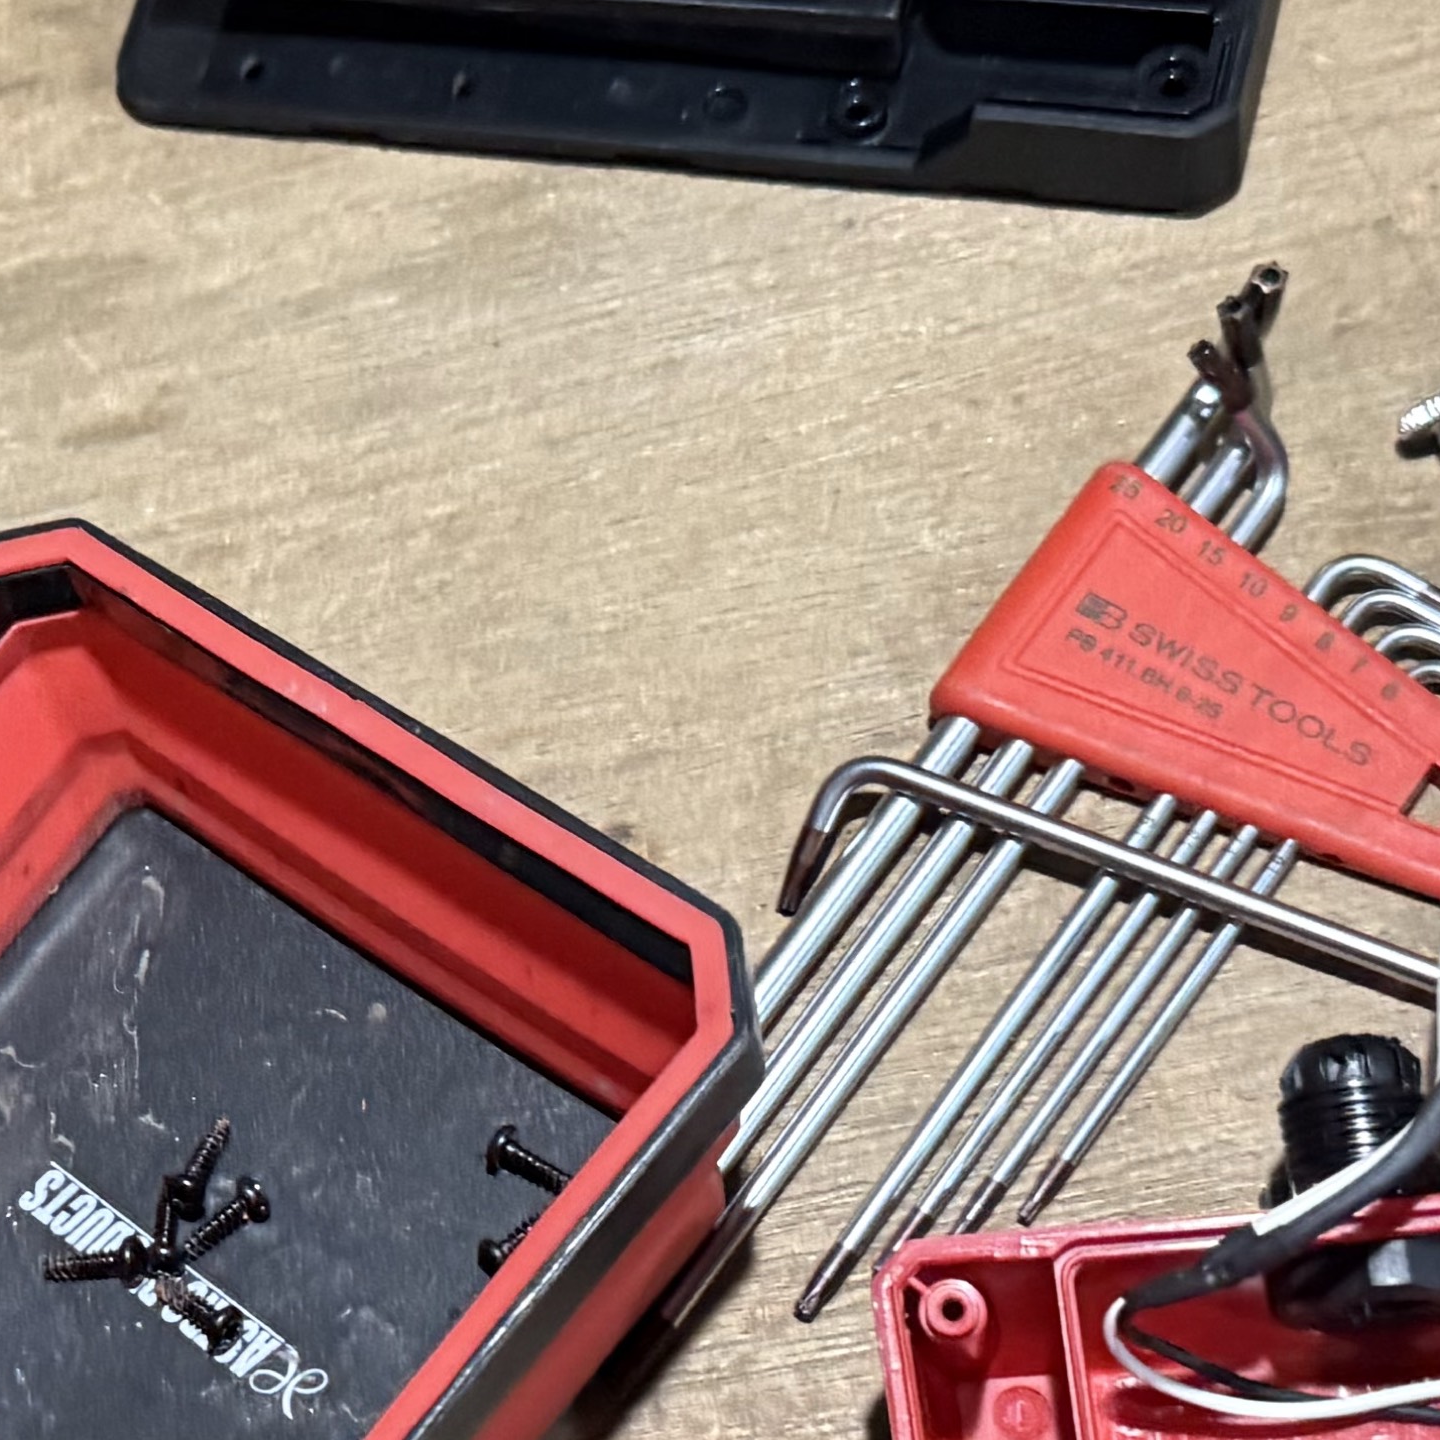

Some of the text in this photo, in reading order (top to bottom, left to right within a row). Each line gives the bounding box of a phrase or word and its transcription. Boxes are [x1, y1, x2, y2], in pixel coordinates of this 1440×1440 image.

[1155, 509, 1188, 535] 20
[1197, 538, 1227, 566] 15
[1239, 570, 1269, 599] 10
[1278, 603, 1299, 623] 9
[1350, 657, 1370, 674] 7
[1128, 622, 1243, 695] SWISS
[1250, 681, 1371, 767] TOOLS
